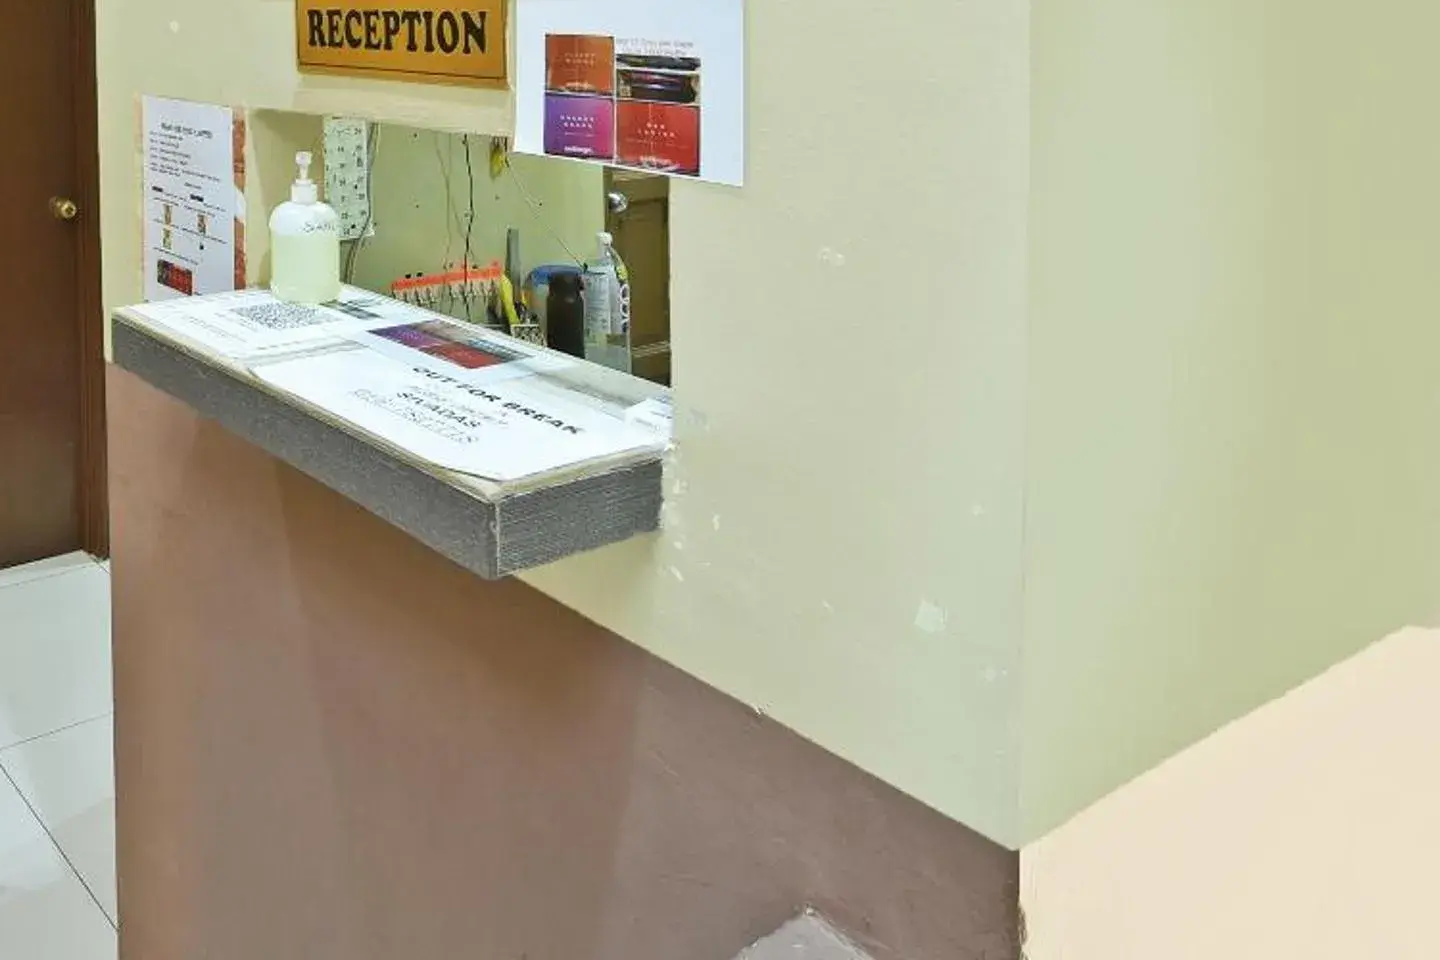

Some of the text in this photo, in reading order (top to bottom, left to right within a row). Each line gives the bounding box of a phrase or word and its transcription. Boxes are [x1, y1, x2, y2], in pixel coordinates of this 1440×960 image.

[307, 9, 487, 55] RECEPTION
[412, 366, 458, 383] OUT
[457, 383, 501, 403] FOR
[502, 400, 587, 434] BREAK
